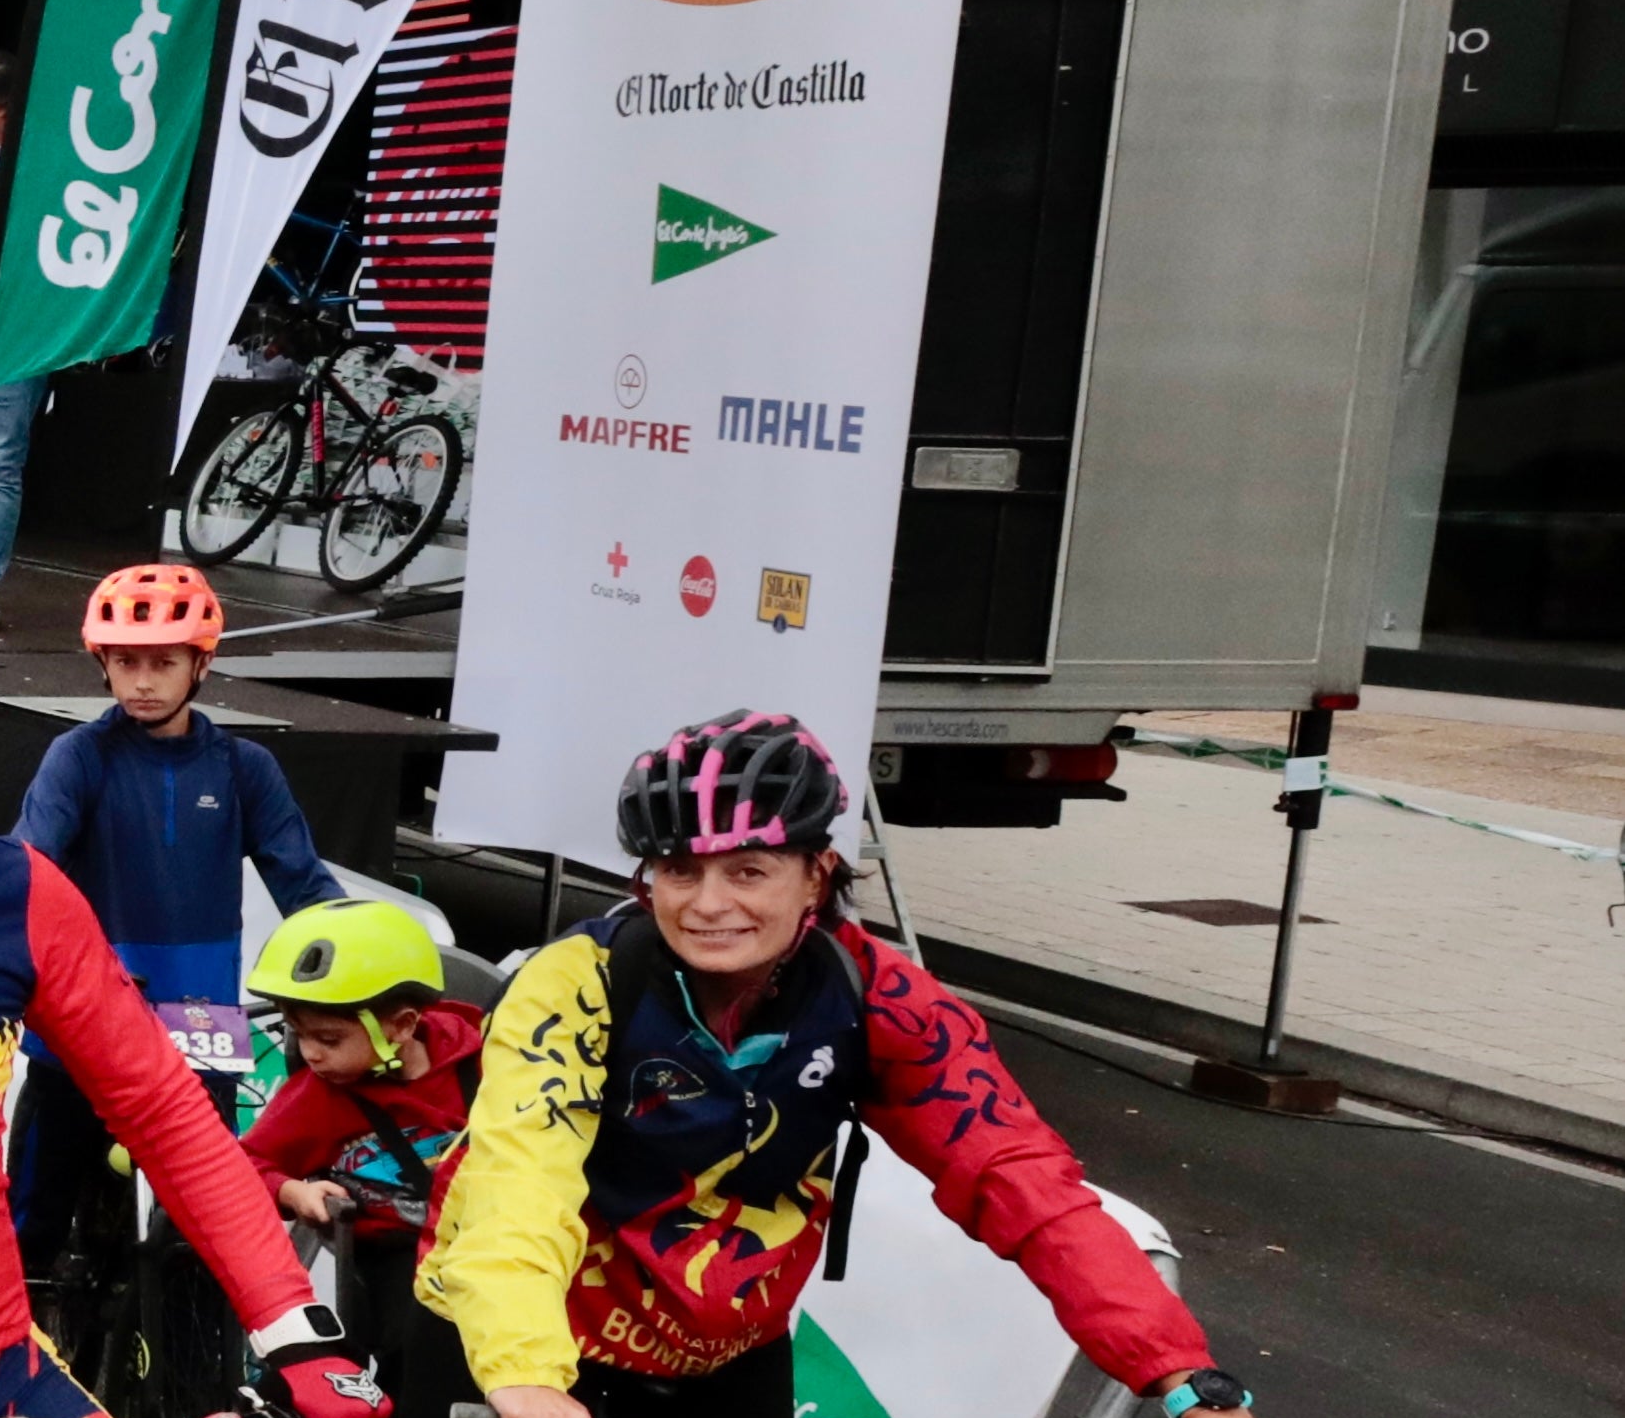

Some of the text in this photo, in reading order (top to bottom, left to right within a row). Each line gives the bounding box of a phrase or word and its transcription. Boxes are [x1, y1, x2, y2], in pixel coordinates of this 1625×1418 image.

[240, 20, 360, 159] El
[649, 71, 719, 115] Norte
[723, 71, 748, 112] de
[750, 59, 867, 110] Castilla
[38, 181, 140, 291] El
[672, 220, 708, 243] Corte
[559, 394, 866, 454] MAPFRE MAHLE
[590, 582, 642, 605] Cruz Roja
